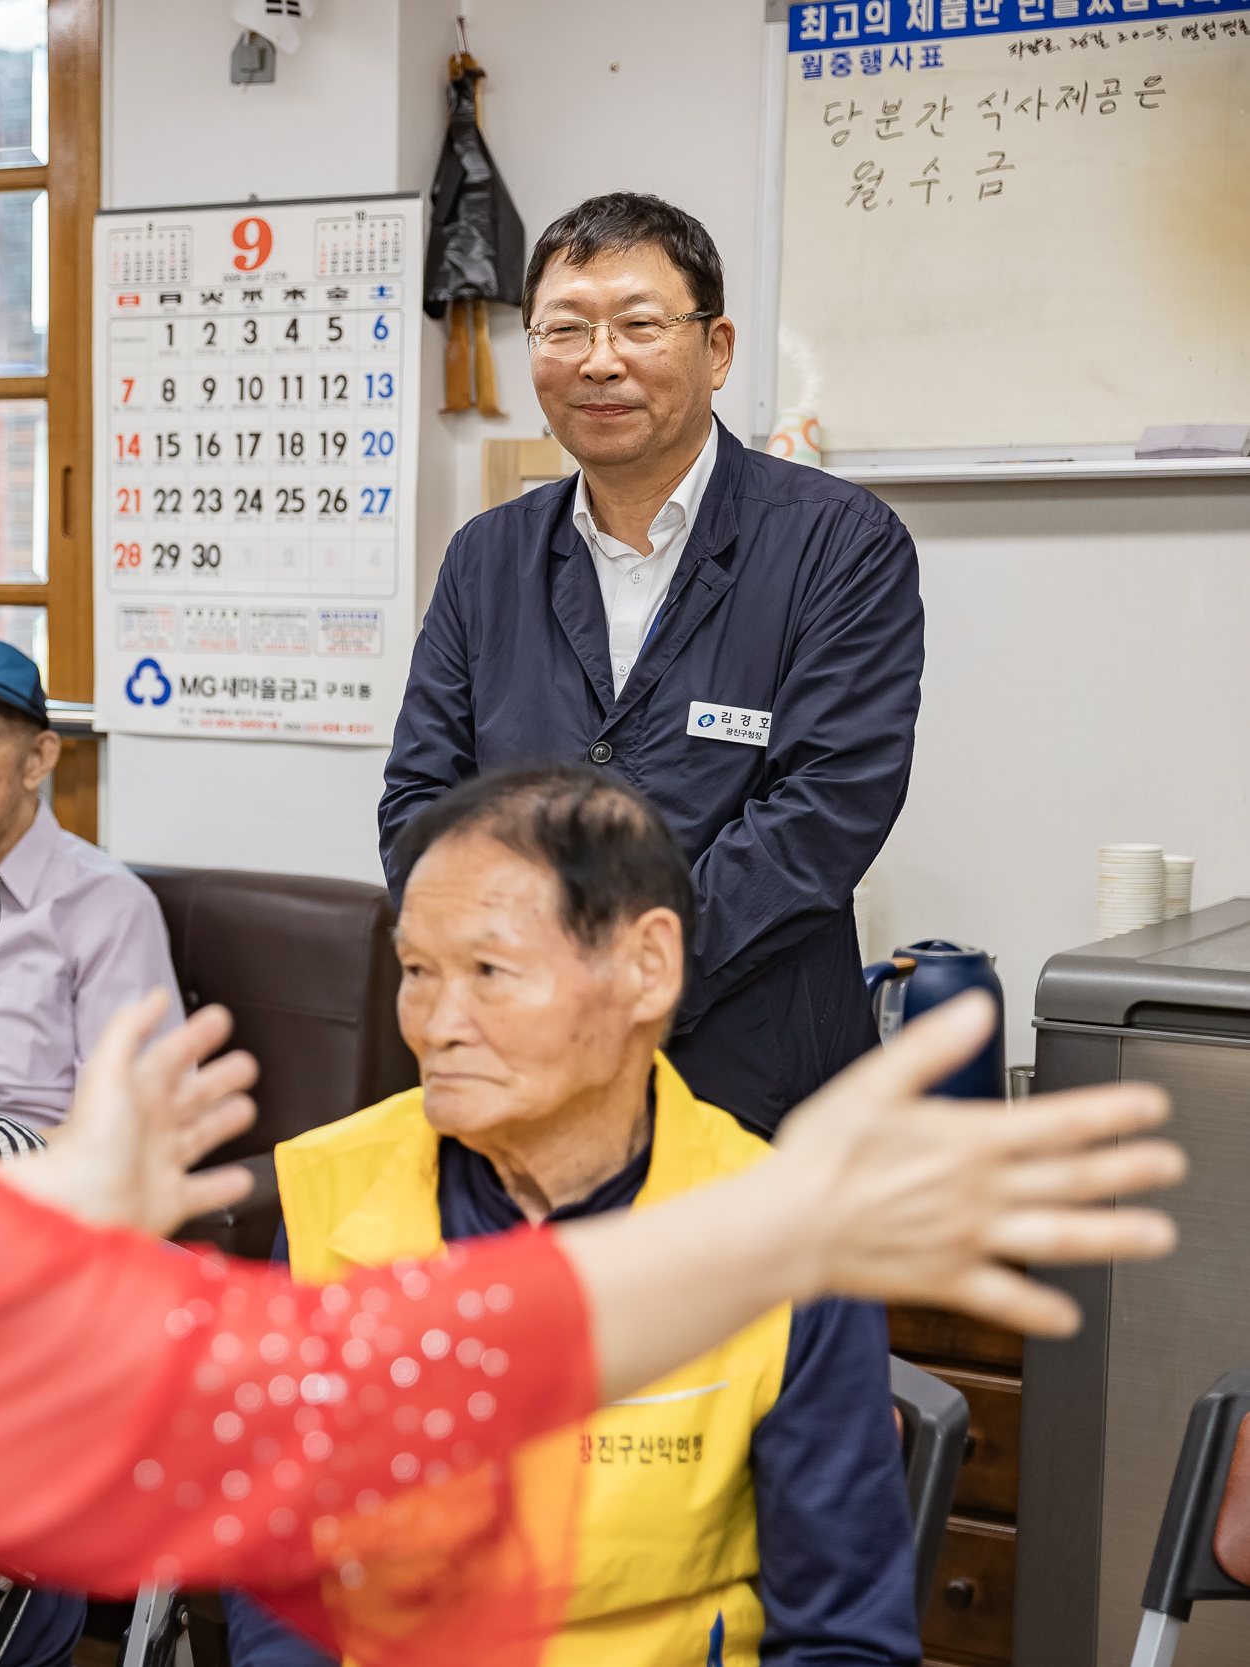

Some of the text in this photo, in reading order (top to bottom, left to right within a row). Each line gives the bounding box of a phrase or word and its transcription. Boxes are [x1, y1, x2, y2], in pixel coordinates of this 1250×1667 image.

[799, 1, 892, 42] 최고의
[801, 44, 945, 80] 월중행사표
[823, 95, 954, 147] 당분간
[975, 150, 1016, 202] 금
[232, 217, 273, 271] 9
[117, 284, 394, 307] 日 月 火 水 木 金 土
[165, 313, 390, 347] 1 2 3 4 5 6
[121, 372, 395, 405] 7 8 9 10 11 12 13
[116, 430, 395, 460] 14 15 16 17 18 19 20
[117, 487, 393, 515] 21 22 23 24 25 26 27
[113, 542, 142, 569] 28
[152, 542, 182, 570] 29
[191, 543, 222, 570] 30
[725, 727, 763, 740] 광진구청장
